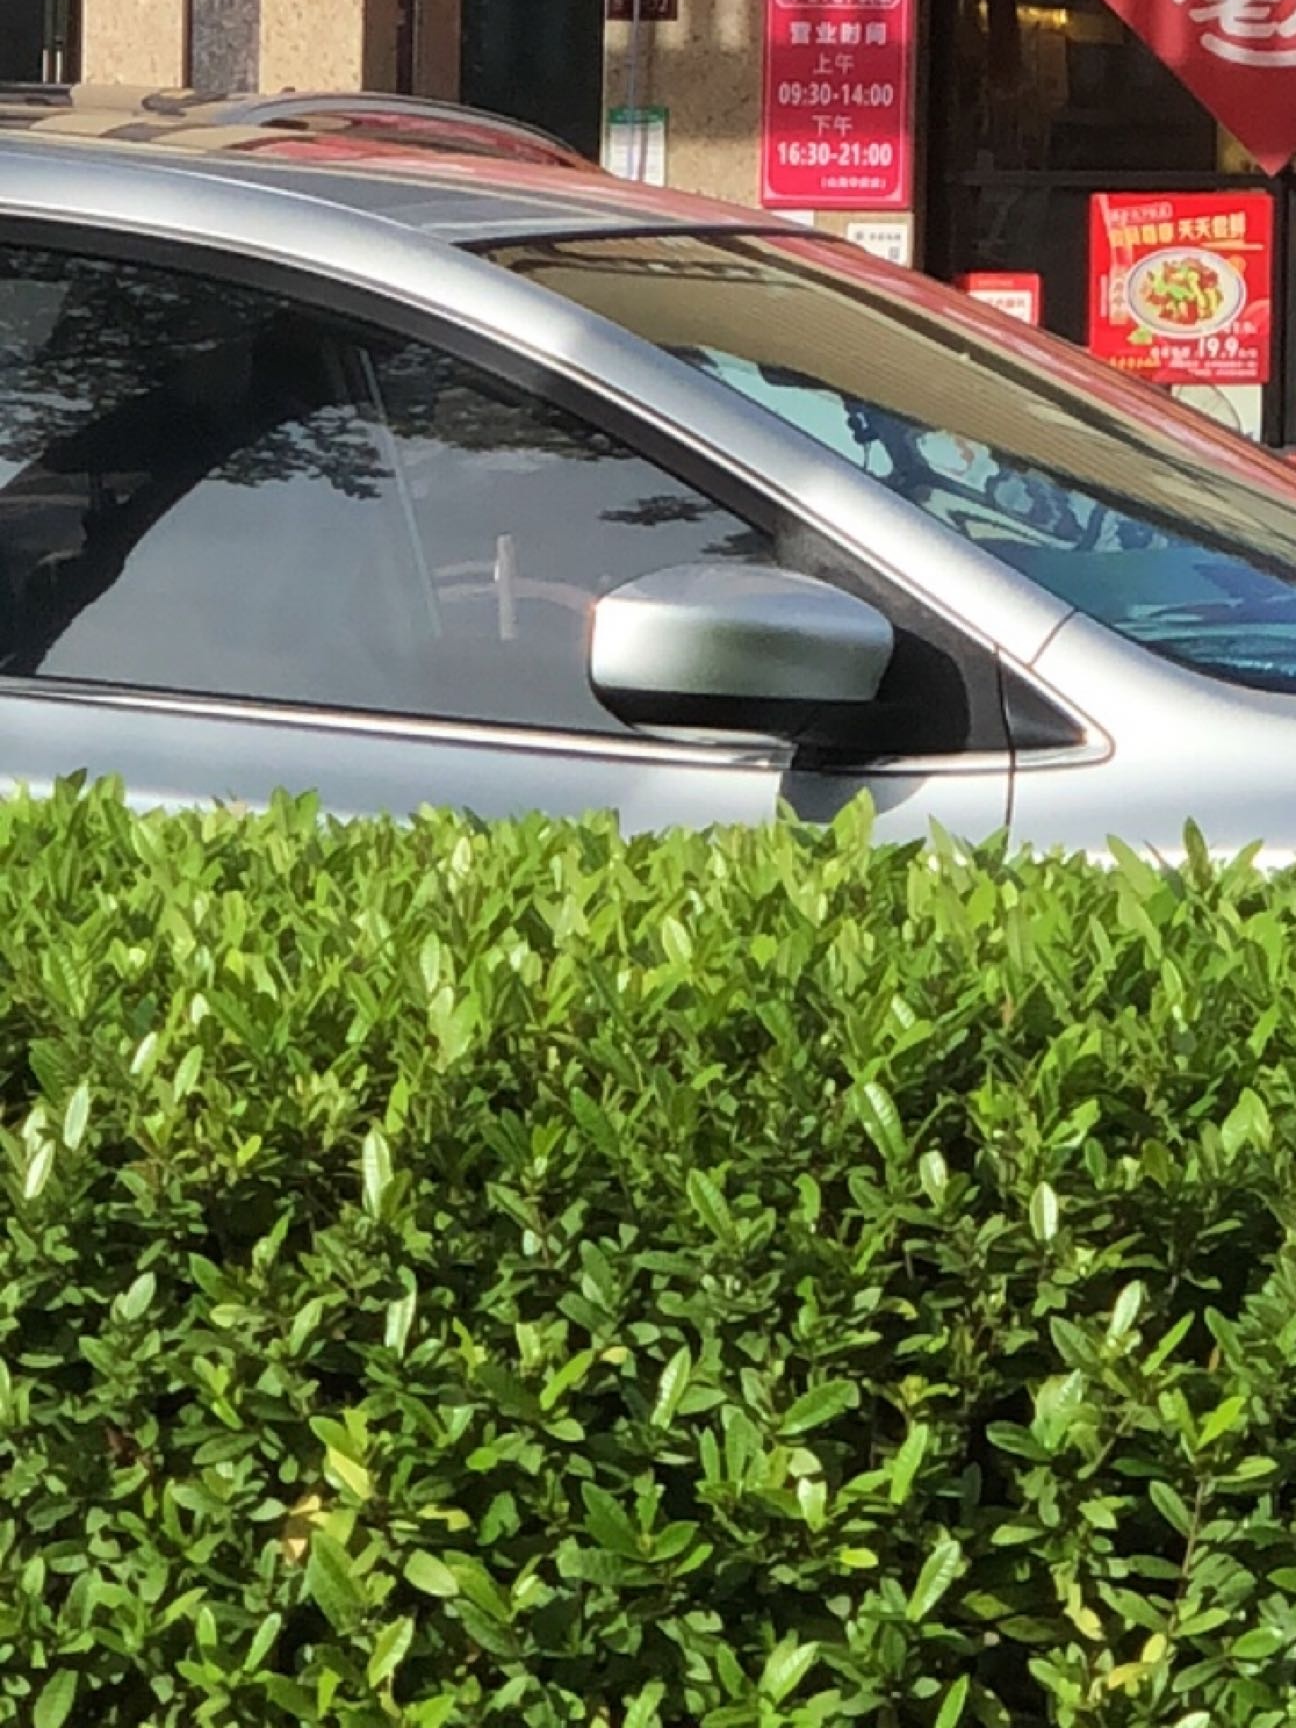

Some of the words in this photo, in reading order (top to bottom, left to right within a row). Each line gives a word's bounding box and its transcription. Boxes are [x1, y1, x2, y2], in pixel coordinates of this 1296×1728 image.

[790, 21, 887, 45] 营业时间
[812, 52, 855, 76] 上午
[778, 82, 894, 107] 09:30-14:00
[811, 114, 853, 137] 下午
[777, 141, 893, 167] 16:30-21:00
